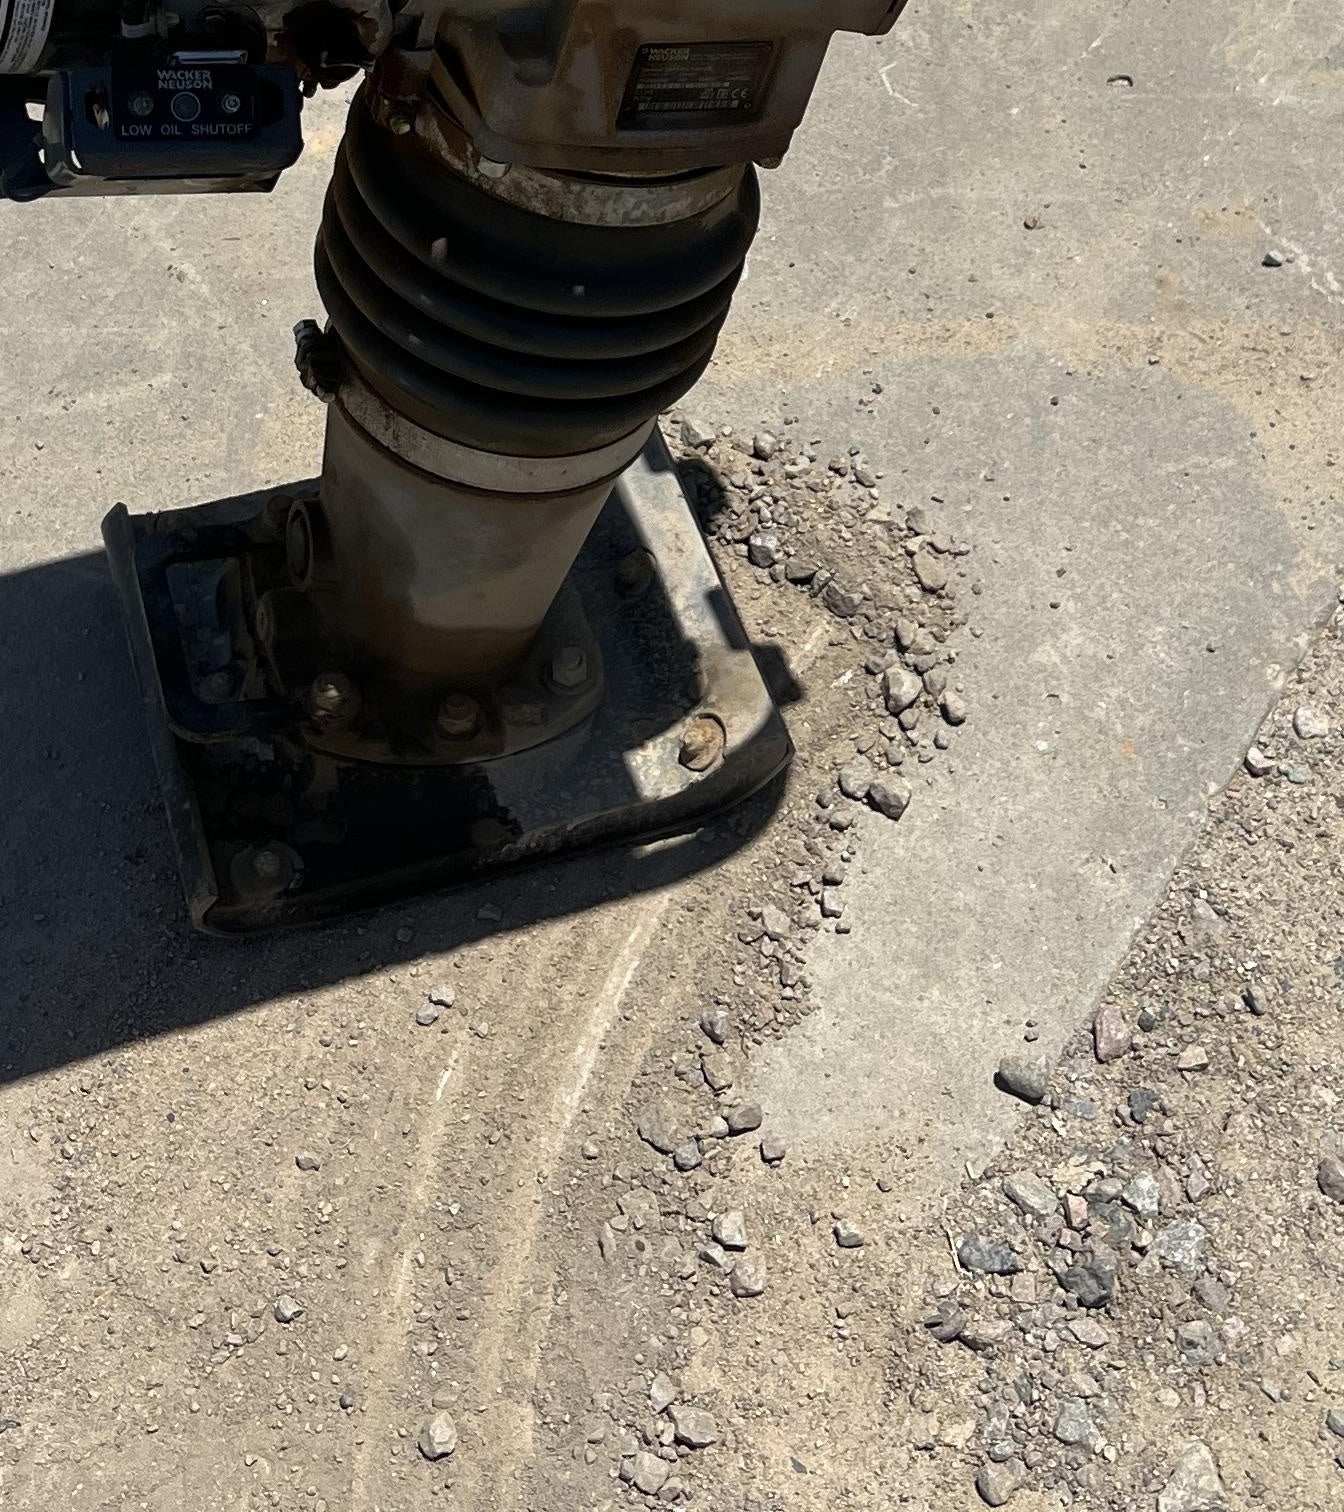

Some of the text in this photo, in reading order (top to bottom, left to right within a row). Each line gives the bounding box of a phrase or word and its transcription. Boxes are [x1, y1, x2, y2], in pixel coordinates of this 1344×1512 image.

[156, 69, 213, 80] WACKER
[157, 79, 213, 90] NEUSON
[121, 123, 253, 137] LOW OIL SHUTOFF
